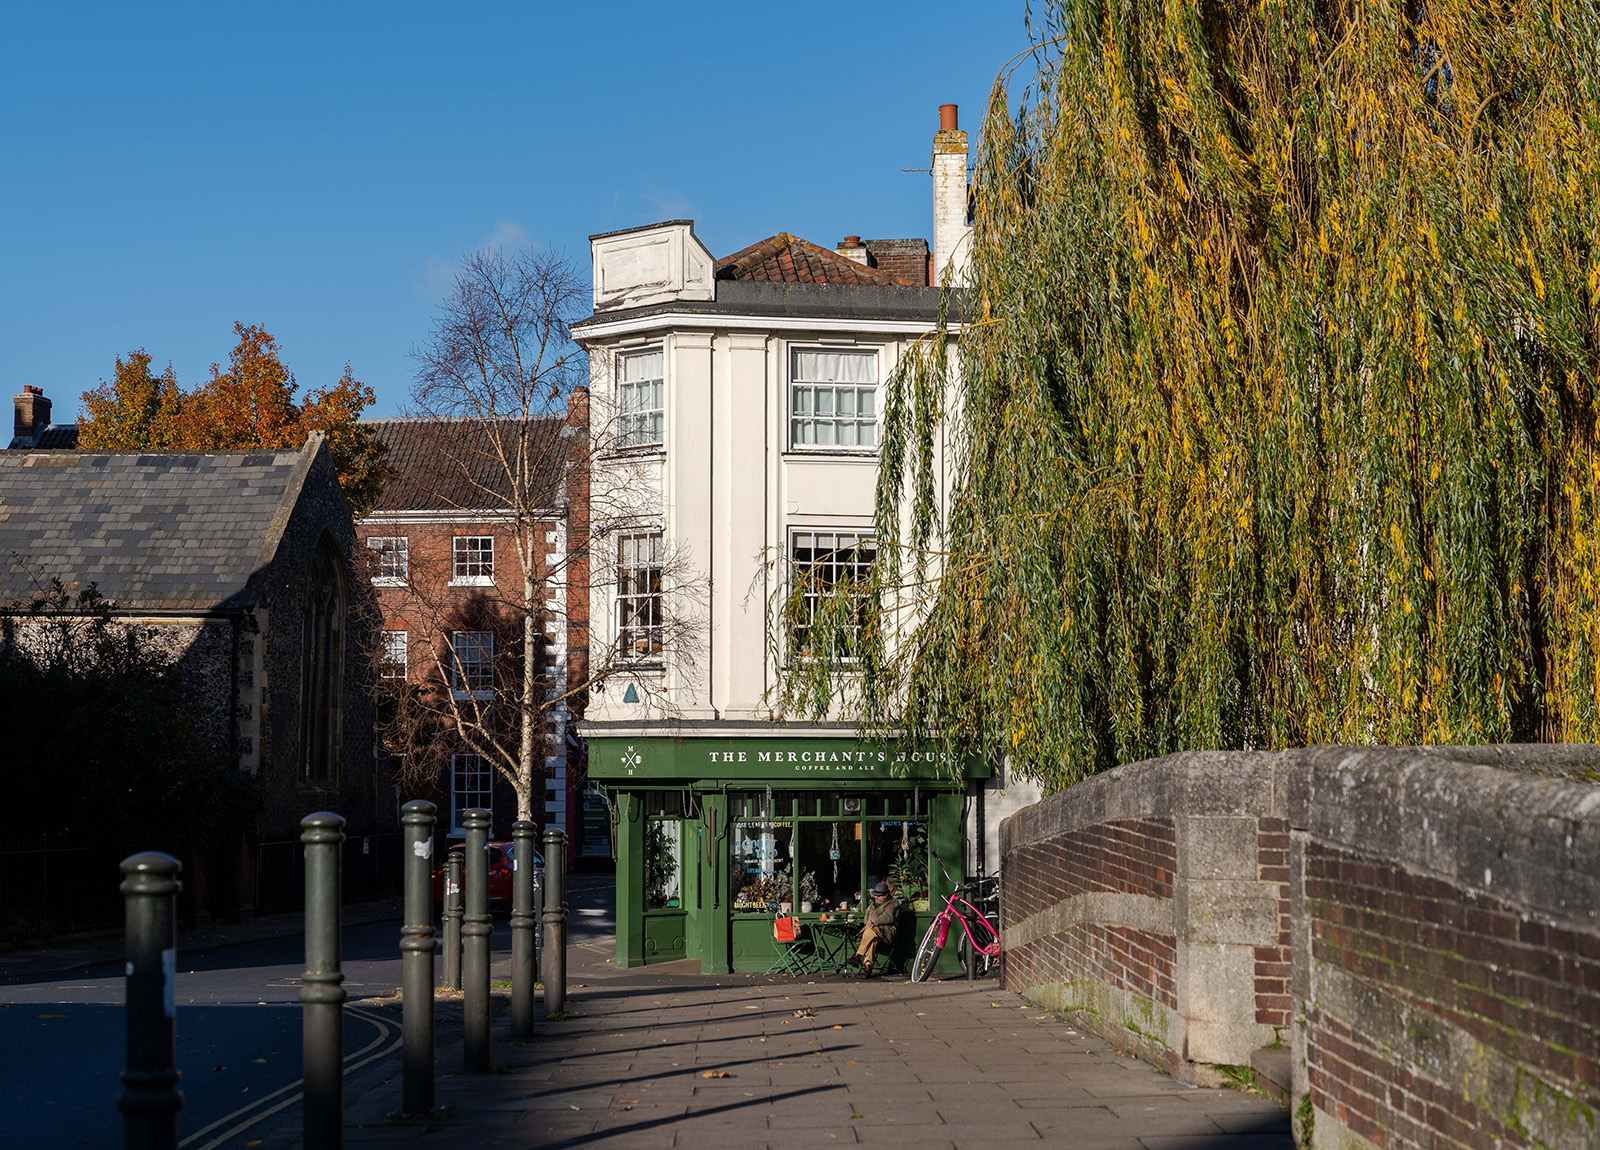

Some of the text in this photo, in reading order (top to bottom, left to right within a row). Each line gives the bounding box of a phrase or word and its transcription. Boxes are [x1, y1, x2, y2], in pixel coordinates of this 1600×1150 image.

[709, 751, 959, 762] THE MERCHANT'S HOUS
